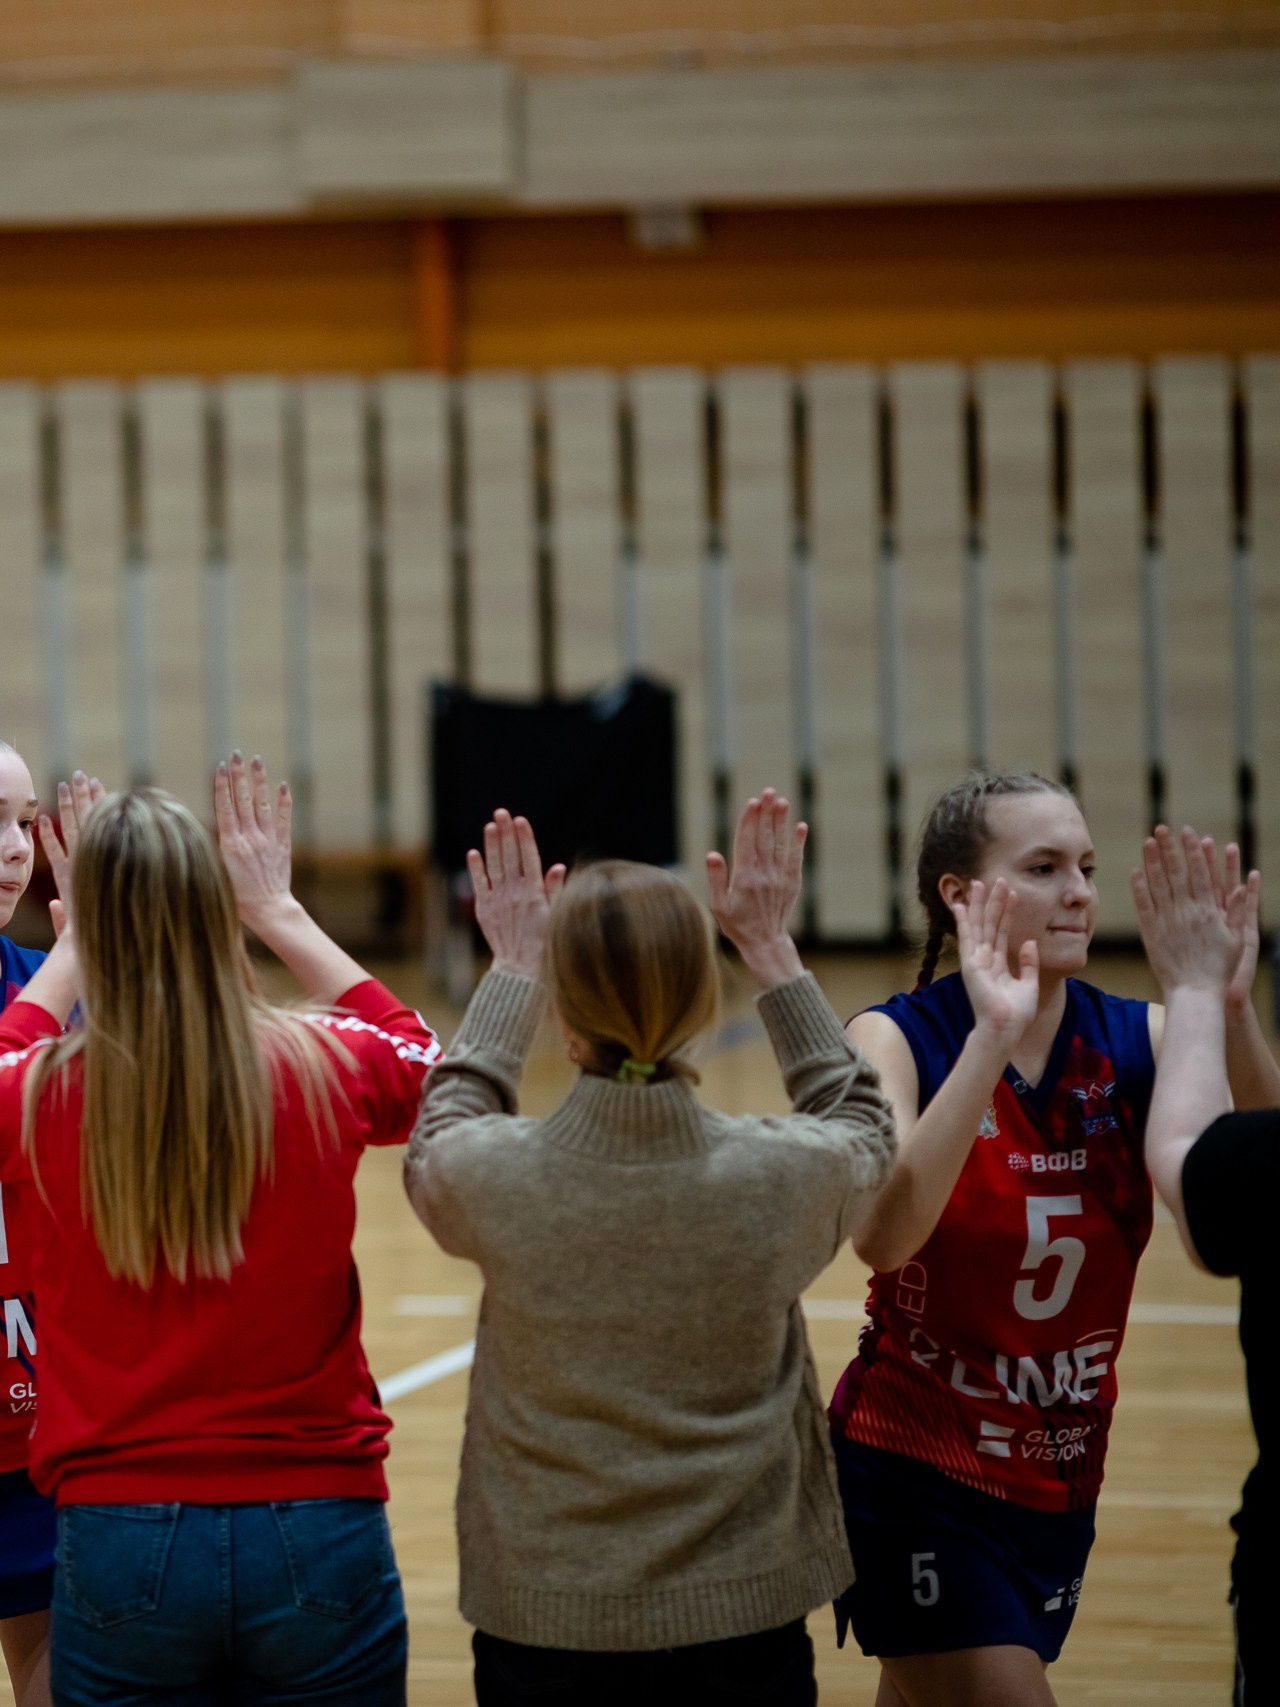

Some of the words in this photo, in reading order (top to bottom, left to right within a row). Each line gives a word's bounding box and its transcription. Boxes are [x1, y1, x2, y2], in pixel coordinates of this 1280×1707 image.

[1013, 1194, 1087, 1321] 5
[1020, 1438, 1086, 1462] VISION
[910, 1552, 941, 1607] 5
